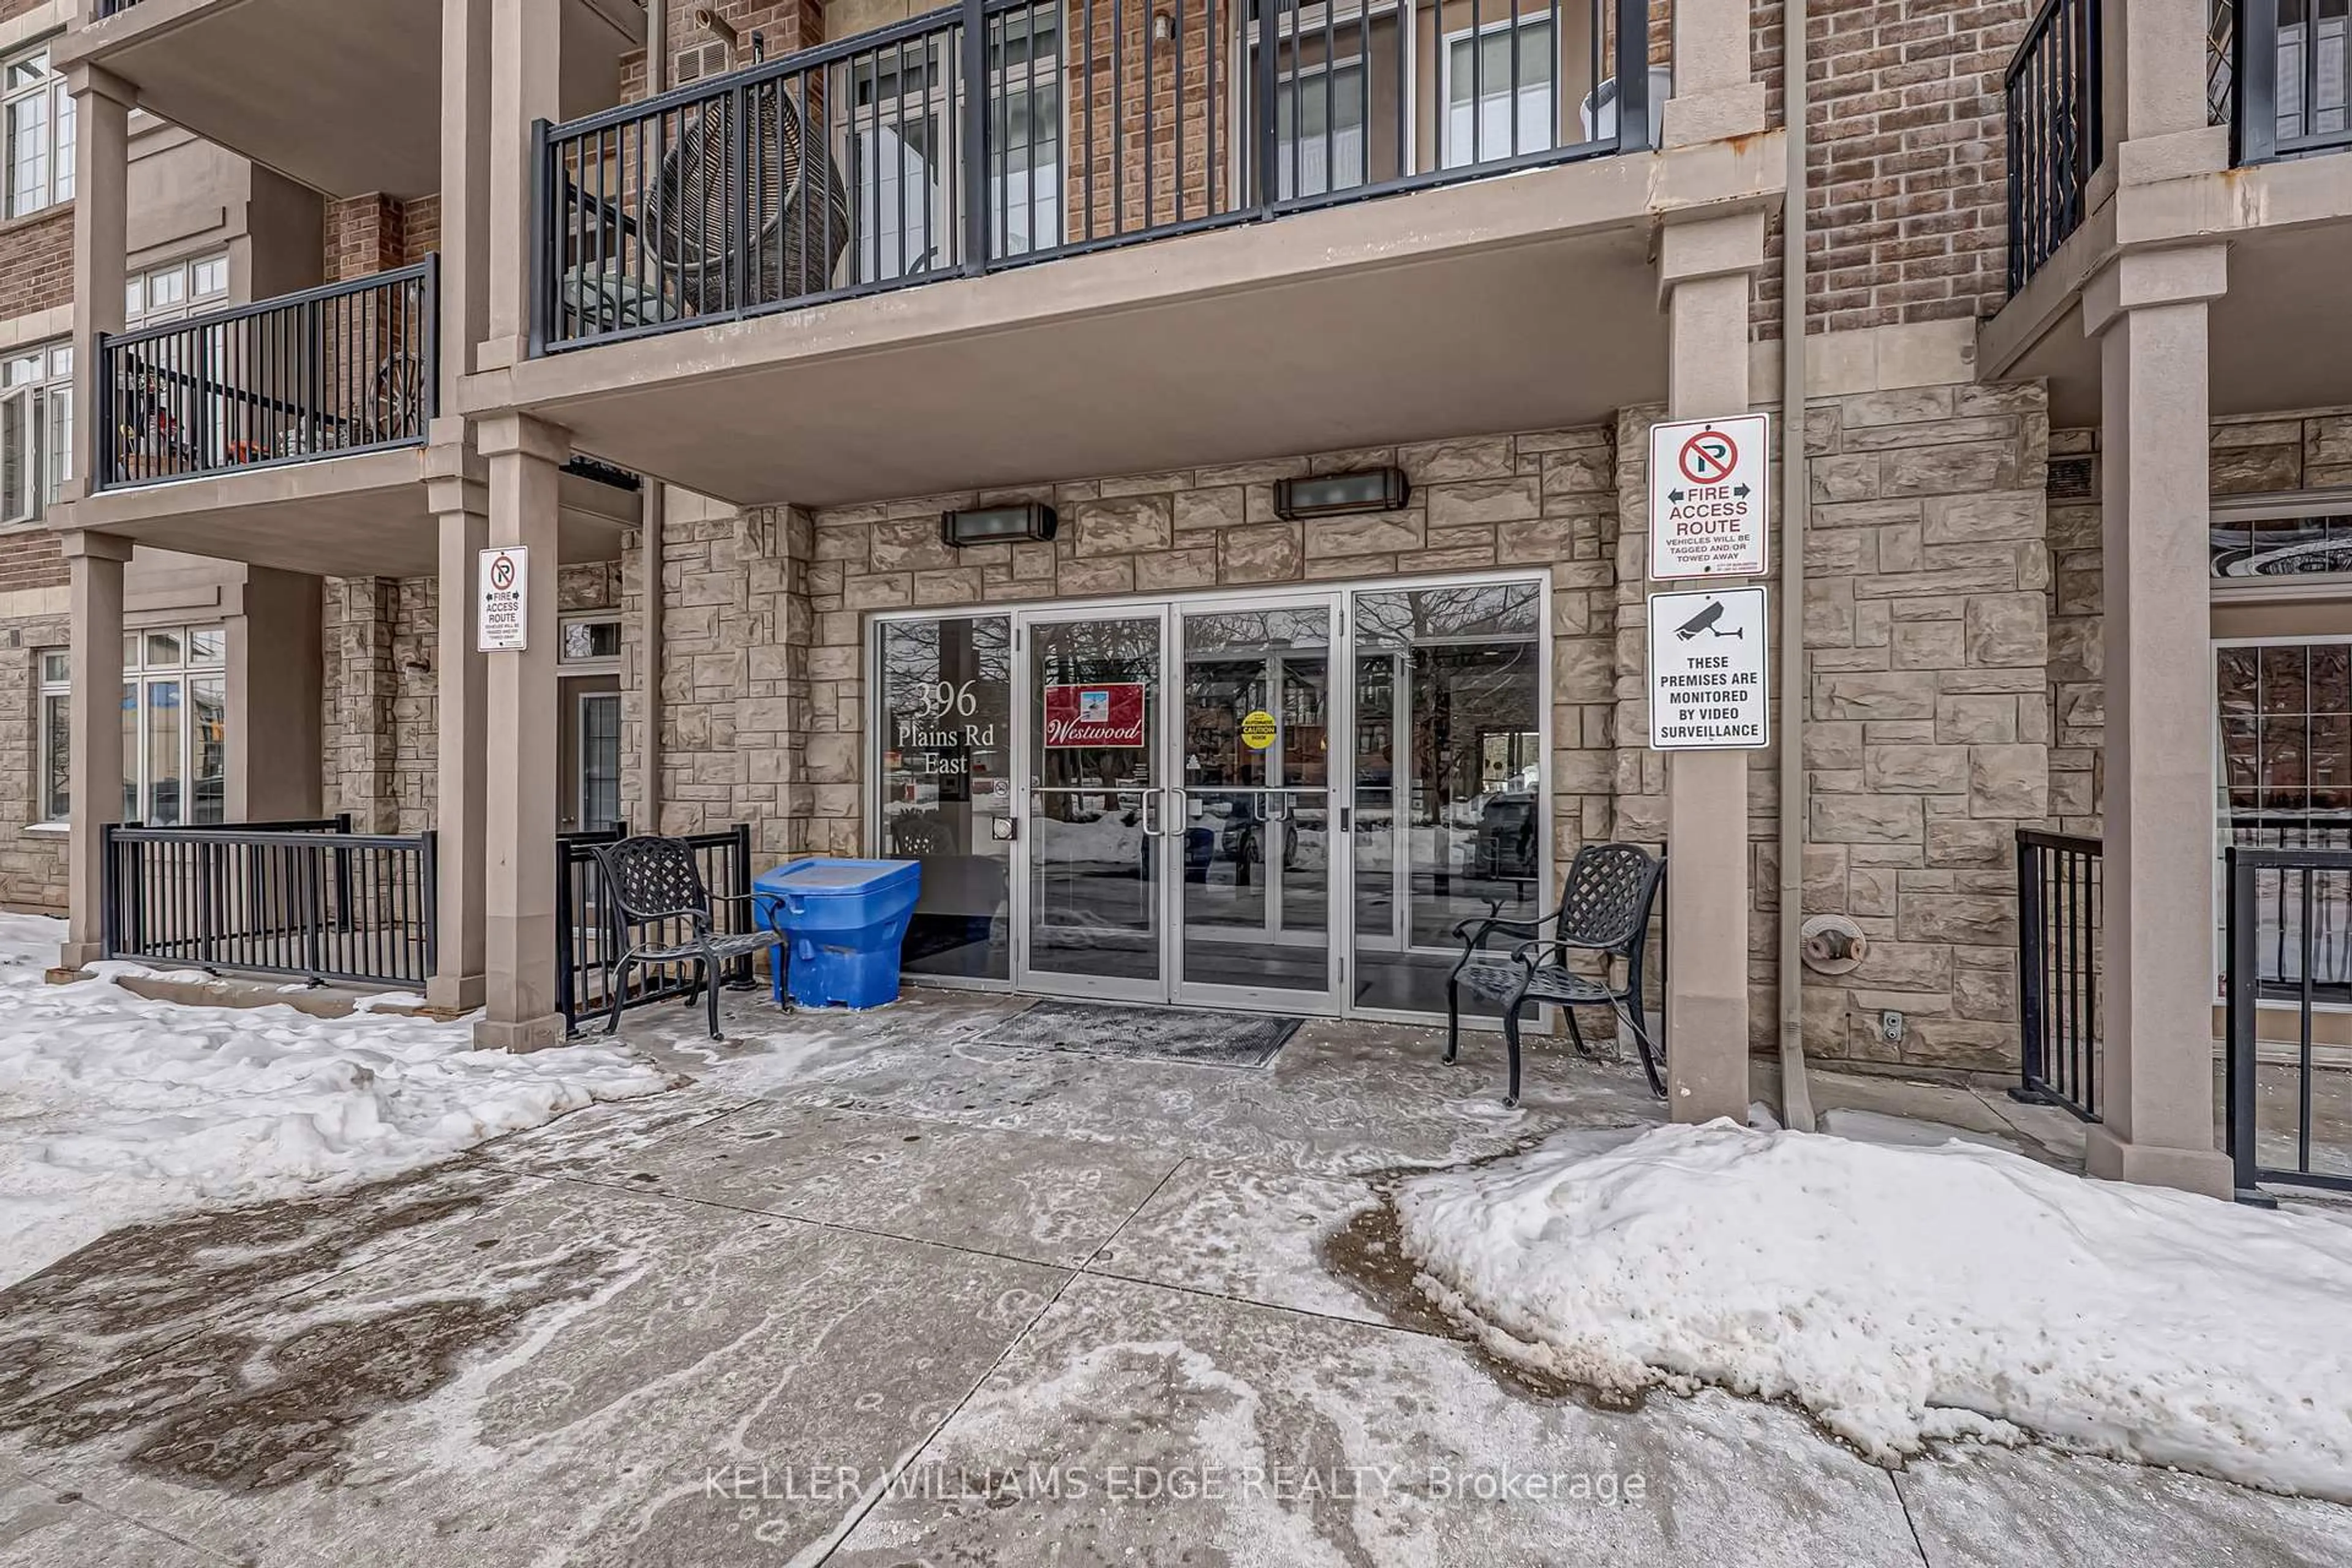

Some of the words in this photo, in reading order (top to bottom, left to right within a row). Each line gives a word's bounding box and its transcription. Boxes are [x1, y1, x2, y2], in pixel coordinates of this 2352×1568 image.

[1689, 486, 1729, 502] FIRE
[1669, 502, 1747, 520] ACCESS
[1677, 519, 1740, 535] ROUTE
[1666, 537, 1711, 546] VEHICLES
[1670, 546, 1707, 554] TAGGED
[494, 592, 511, 601] FIRE
[486, 602, 519, 612] ACCESS
[489, 613, 516, 623] ROUTE
[1687, 657, 1728, 669] THESE
[1660, 674, 1727, 687] PREMISES
[1732, 673, 1757, 684] ARE
[914, 680, 976, 718] 396
[1670, 690, 1747, 704] MONITORED
[1679, 709, 1694, 720] BY
[1699, 707, 1739, 720] VIDEO
[897, 722, 957, 747] Plains
[965, 723, 995, 746] Rd
[1047, 715, 1141, 744] Westwood
[1661, 725, 1758, 738] SURVEILLANCE
[923, 752, 968, 774] East
